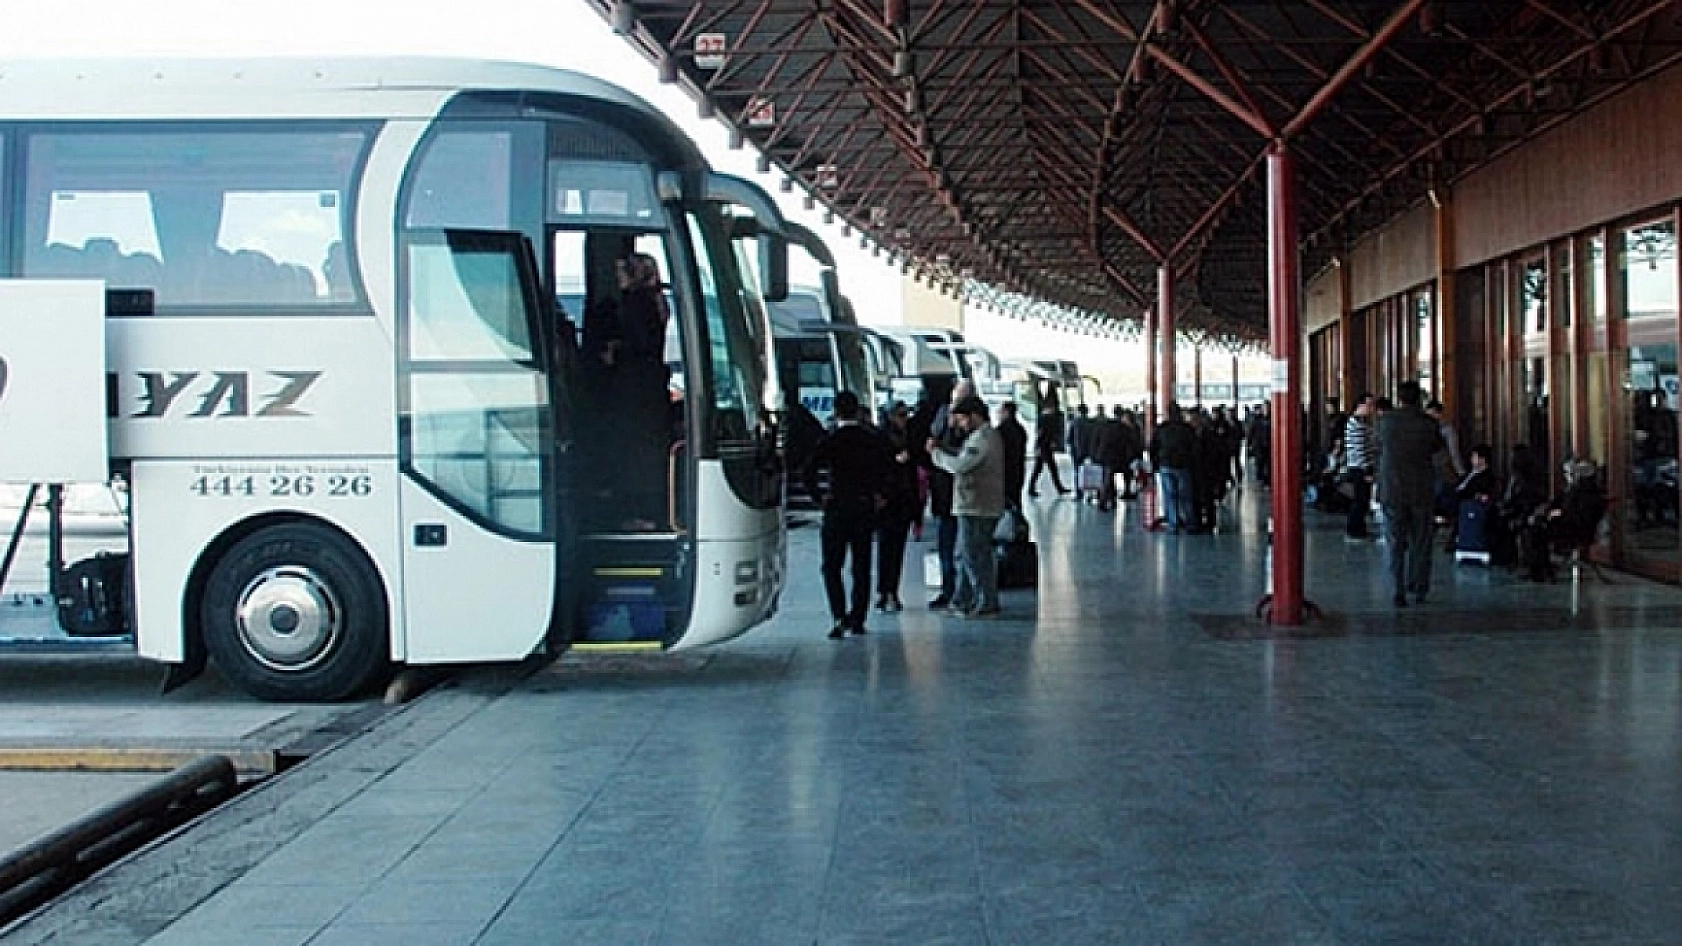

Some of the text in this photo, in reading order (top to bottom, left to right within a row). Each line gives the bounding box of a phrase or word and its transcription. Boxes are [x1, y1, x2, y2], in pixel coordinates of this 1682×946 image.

[189, 475, 372, 496] 444 26 26
